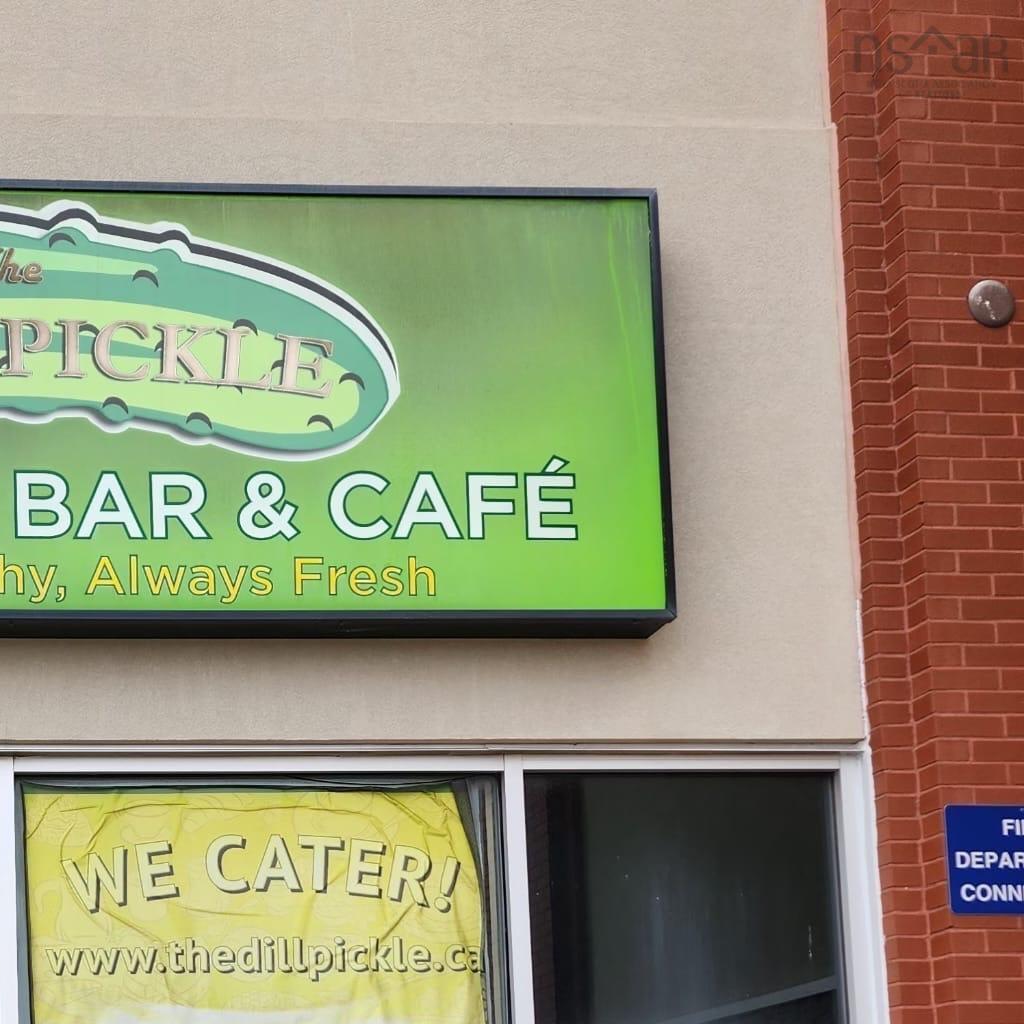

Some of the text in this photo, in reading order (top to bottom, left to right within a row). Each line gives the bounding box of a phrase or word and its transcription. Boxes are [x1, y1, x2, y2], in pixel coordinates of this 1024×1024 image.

[13, 469, 208, 540] BAR
[237, 470, 300, 542] &
[327, 455, 579, 541] CAFÉ
[86, 556, 274, 603] Always
[293, 556, 438, 597] Fresh
[1002, 818, 1024, 836] FI
[60, 833, 462, 914] WE CATER!
[45, 935, 486, 982] www.thedillpickle.ca
